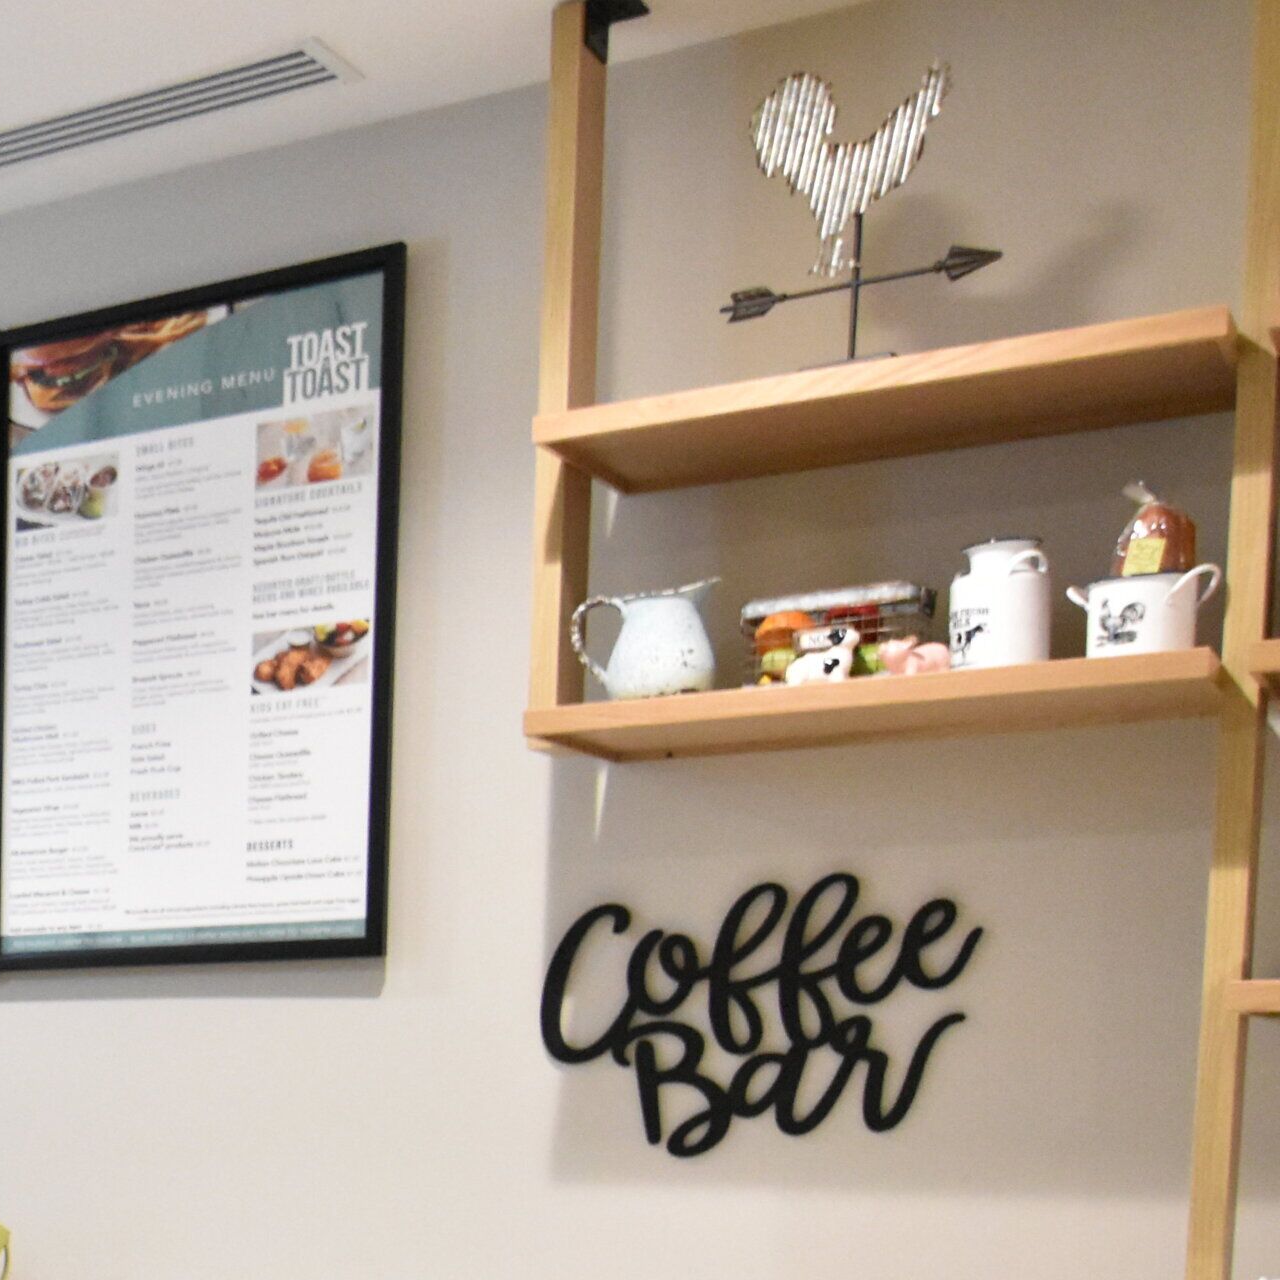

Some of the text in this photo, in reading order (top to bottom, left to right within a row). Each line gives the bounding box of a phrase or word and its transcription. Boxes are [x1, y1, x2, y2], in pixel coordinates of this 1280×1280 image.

[287, 322, 368, 369] TOAST
[132, 366, 276, 409] EVENING MENU
[285, 357, 368, 405] TOAST
[540, 872, 984, 1065] Coffee
[612, 1012, 966, 1158] Bar
